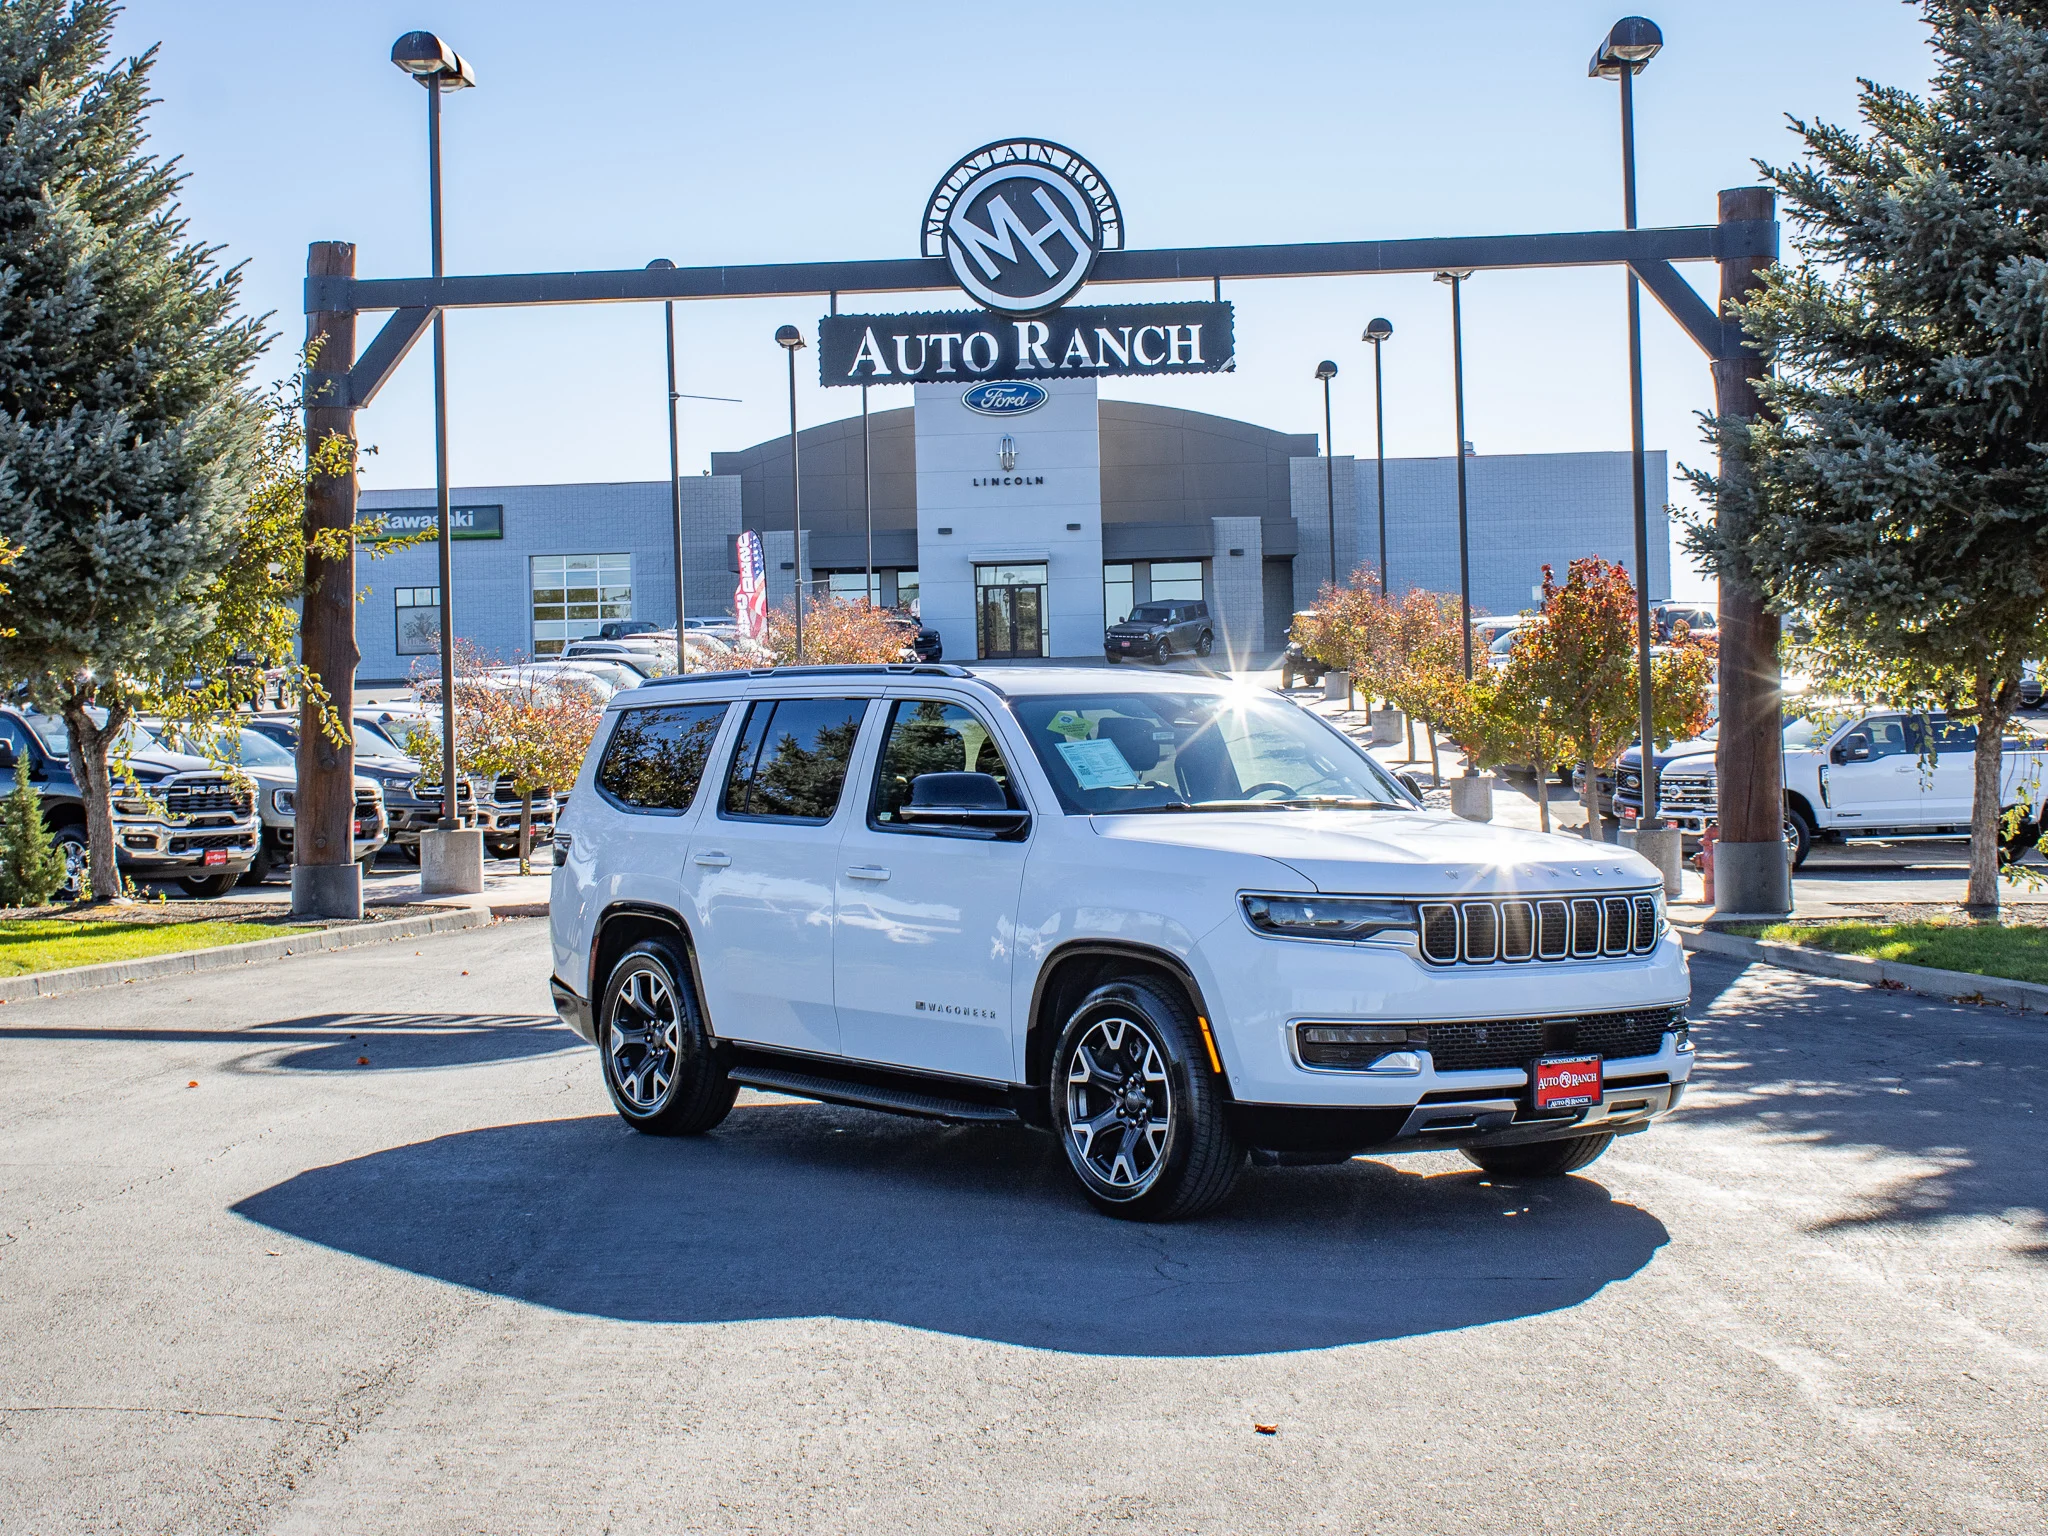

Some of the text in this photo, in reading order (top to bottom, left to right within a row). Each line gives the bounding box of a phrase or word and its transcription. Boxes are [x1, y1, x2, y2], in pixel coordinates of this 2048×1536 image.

[927, 144, 1119, 236] MOUNTAIN HOME
[948, 185, 1093, 282] MH
[847, 321, 1206, 377] AUTO RANCH
[980, 387, 1030, 409] Ford
[973, 476, 1044, 487] LINCOLN
[928, 1003, 996, 1019] WAGONEER
[1538, 1076, 1559, 1089] AUTO
[1572, 1073, 1597, 1086] RANCH
